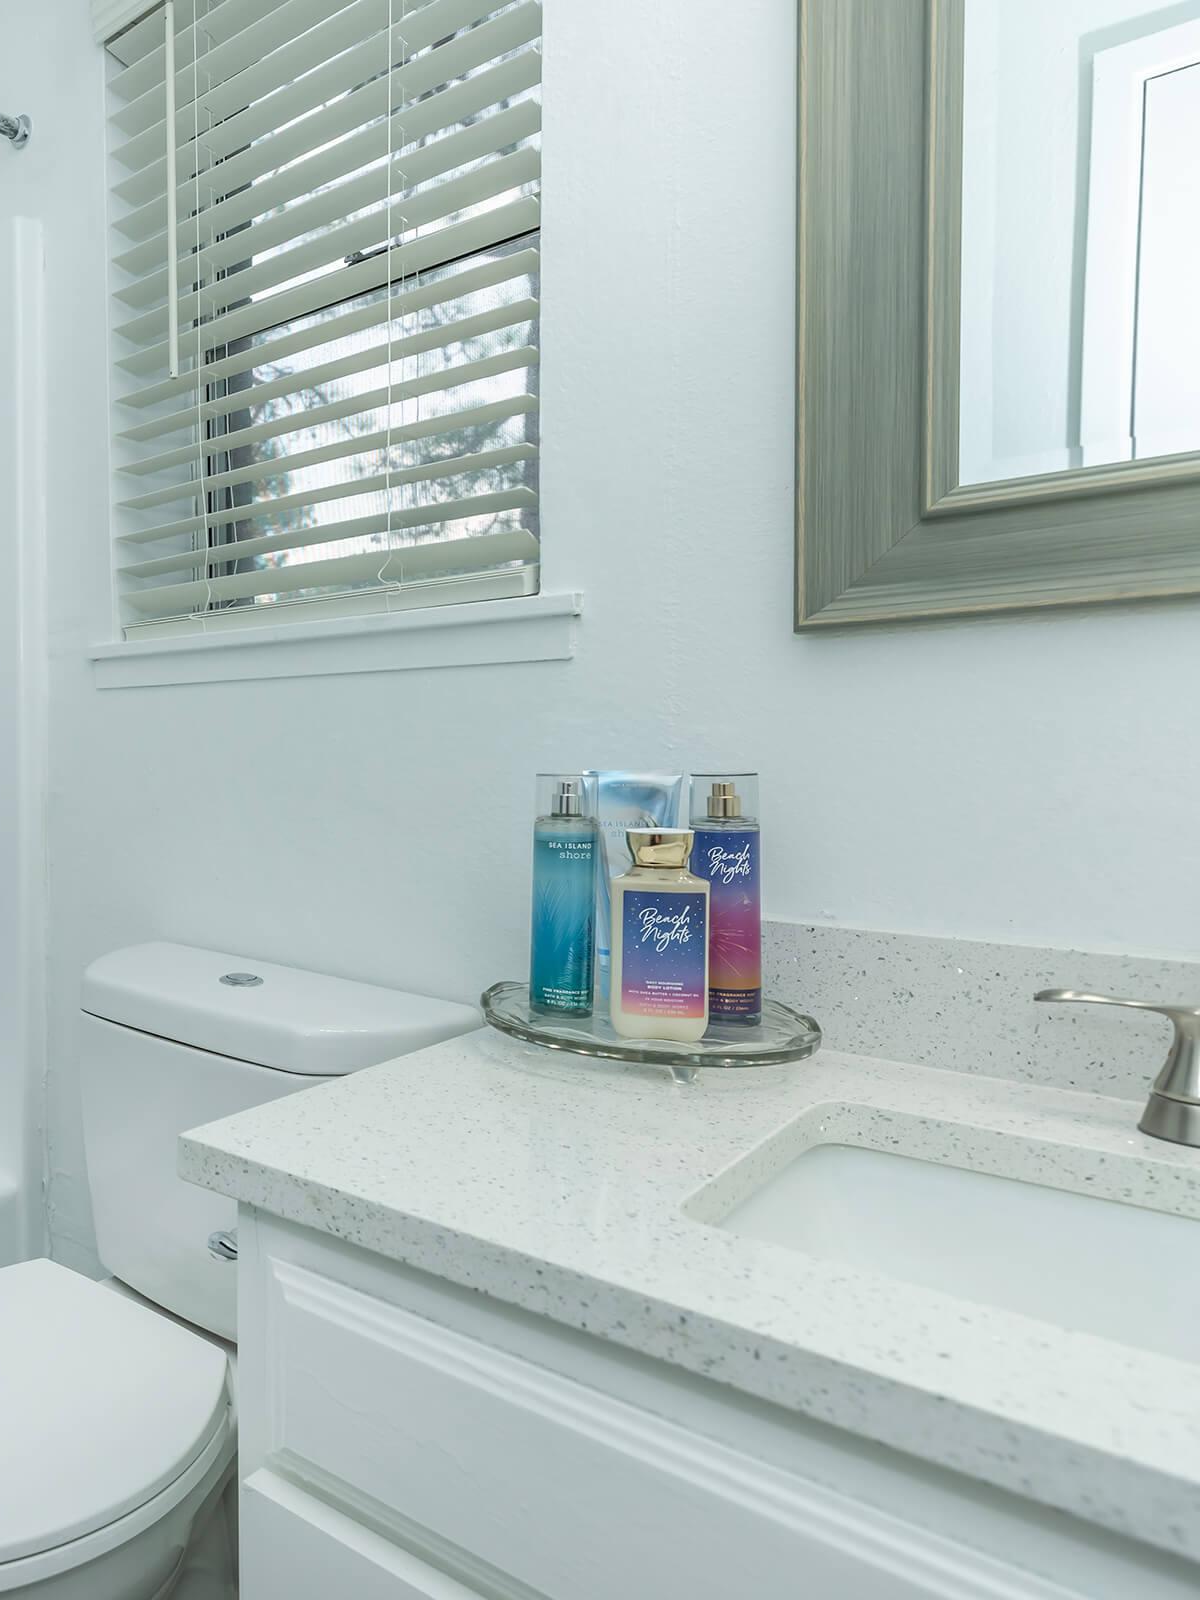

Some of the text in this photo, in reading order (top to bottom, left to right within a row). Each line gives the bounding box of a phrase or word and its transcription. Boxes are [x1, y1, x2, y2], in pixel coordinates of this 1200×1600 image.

[559, 851, 592, 859] shore
[564, 842, 592, 850] ISLAND
[708, 844, 750, 863] Beach
[709, 860, 751, 884] Nights
[638, 905, 690, 927] Beach
[640, 922, 693, 952] Nights
